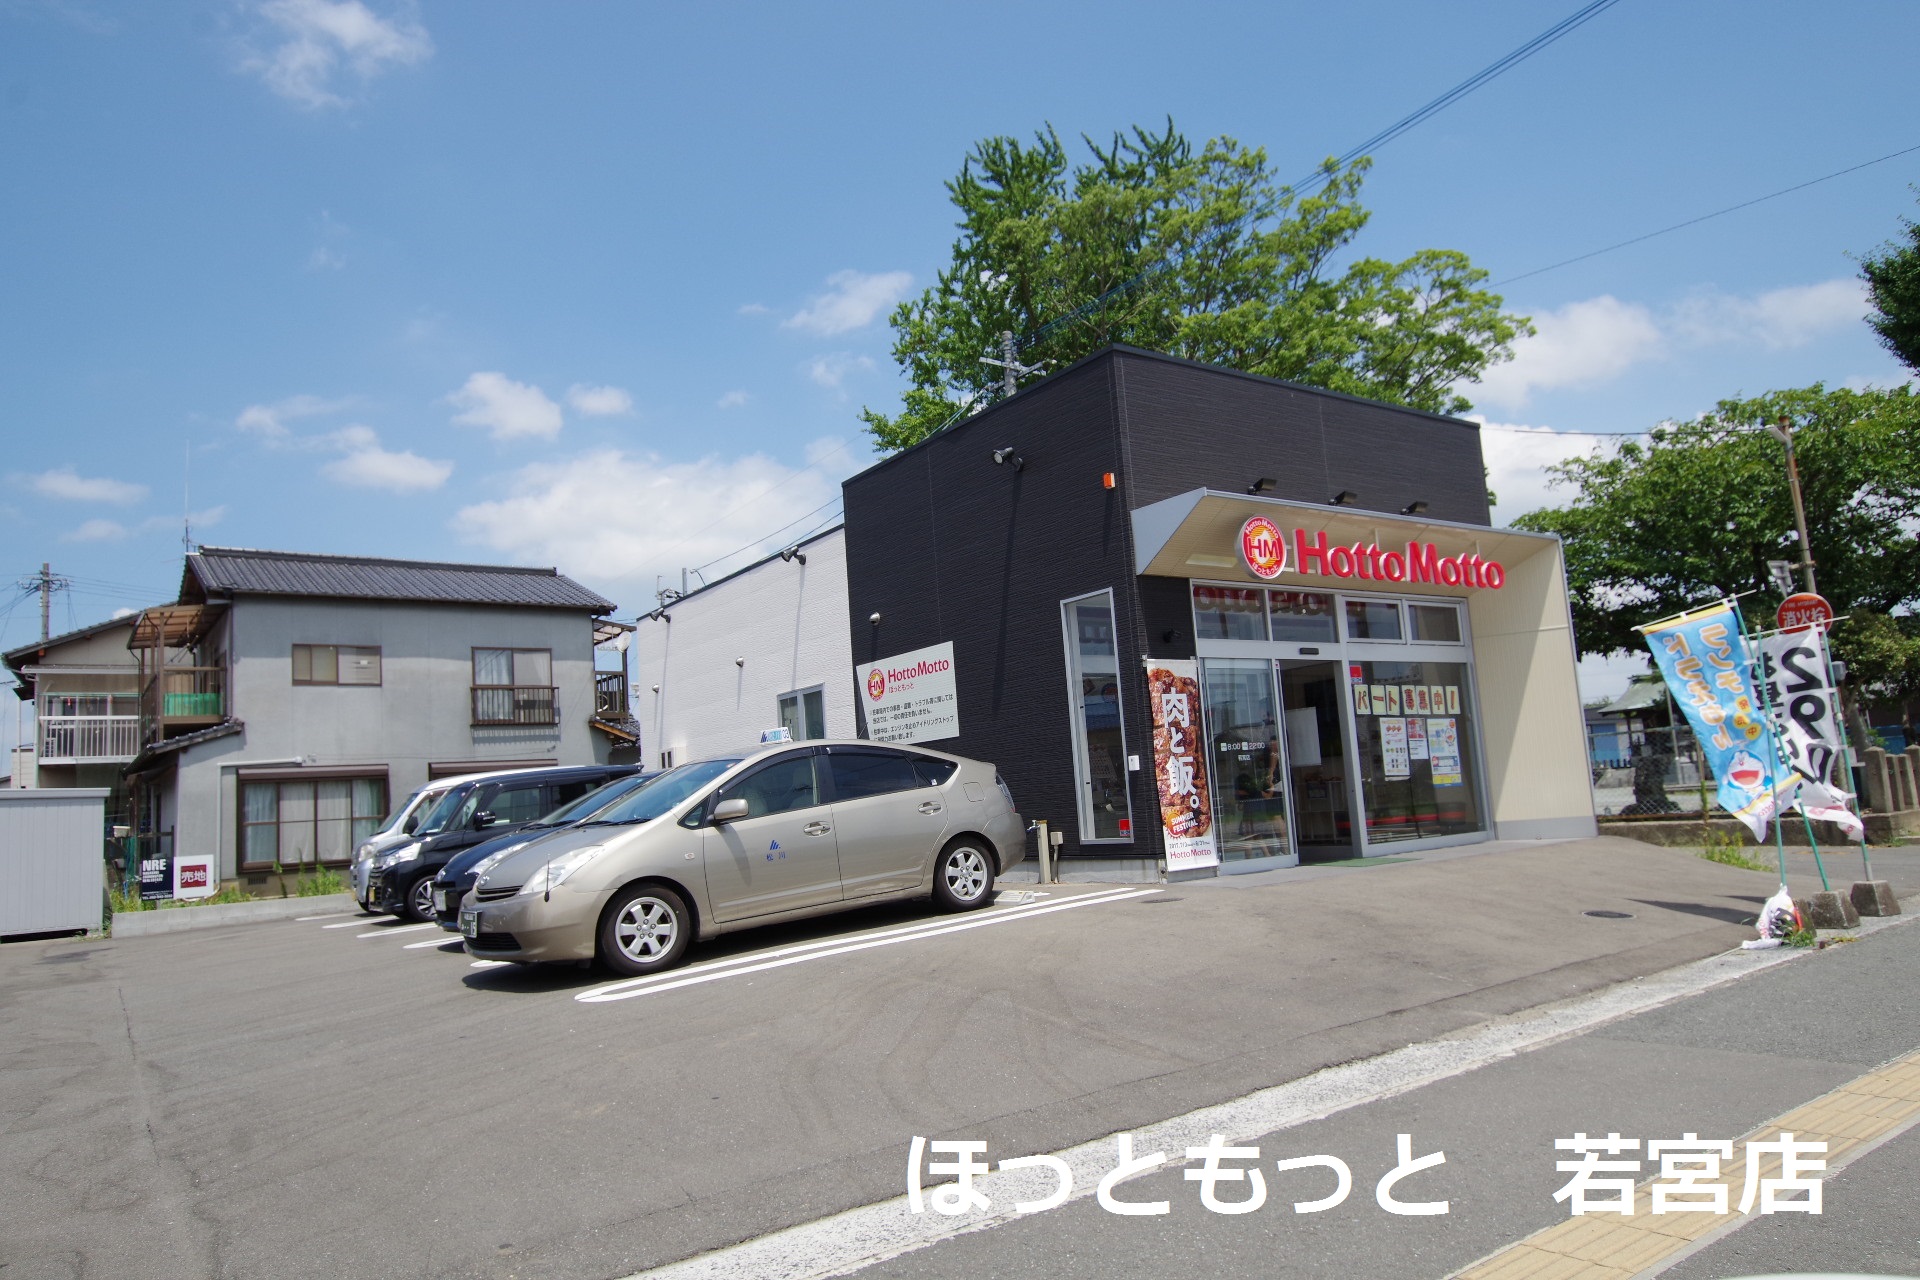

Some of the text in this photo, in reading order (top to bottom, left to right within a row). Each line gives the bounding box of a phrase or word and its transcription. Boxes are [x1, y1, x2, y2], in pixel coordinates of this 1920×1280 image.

[1247, 536, 1280, 561] HM
[1292, 528, 1506, 590] HottoMotto
[887, 659, 950, 684] HottoMotto
[1161, 686, 1200, 809] 肉と飯。
[1171, 812, 1194, 825] SUMMER
[1173, 819, 1198, 833] FESTIVAL
[1169, 849, 1212, 860] HottoMotto
[142, 858, 167, 872] NRE
[181, 869, 207, 883] 売地
